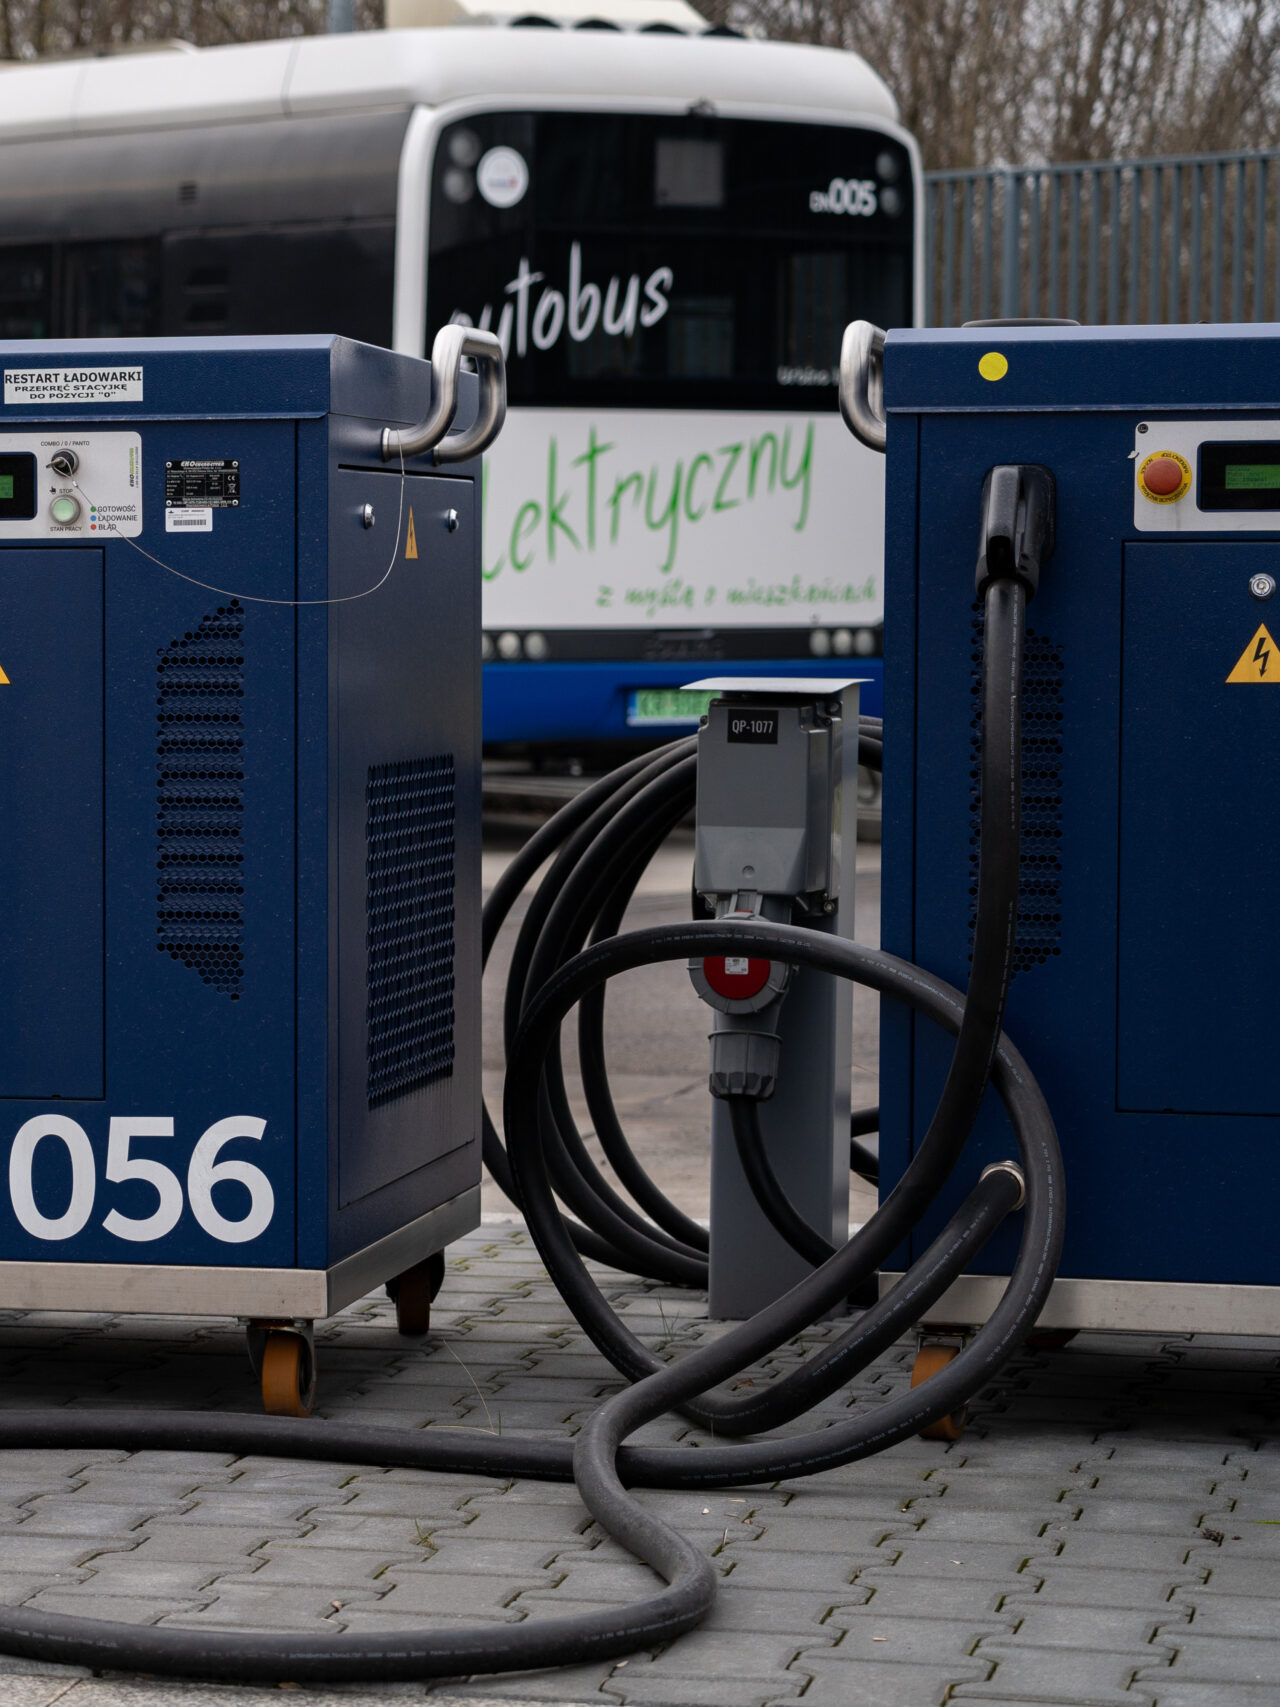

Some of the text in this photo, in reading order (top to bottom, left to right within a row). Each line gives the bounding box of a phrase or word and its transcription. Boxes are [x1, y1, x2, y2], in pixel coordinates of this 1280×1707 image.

[5, 371, 142, 384] RESTART ŁADOWARKI
[15, 383, 127, 392] PRZEKRĘĆ STACYJKĘ
[482, 419, 815, 583] lektryczny
[732, 719, 774, 734] QP-1077
[9, 1113, 275, 1243] 056
